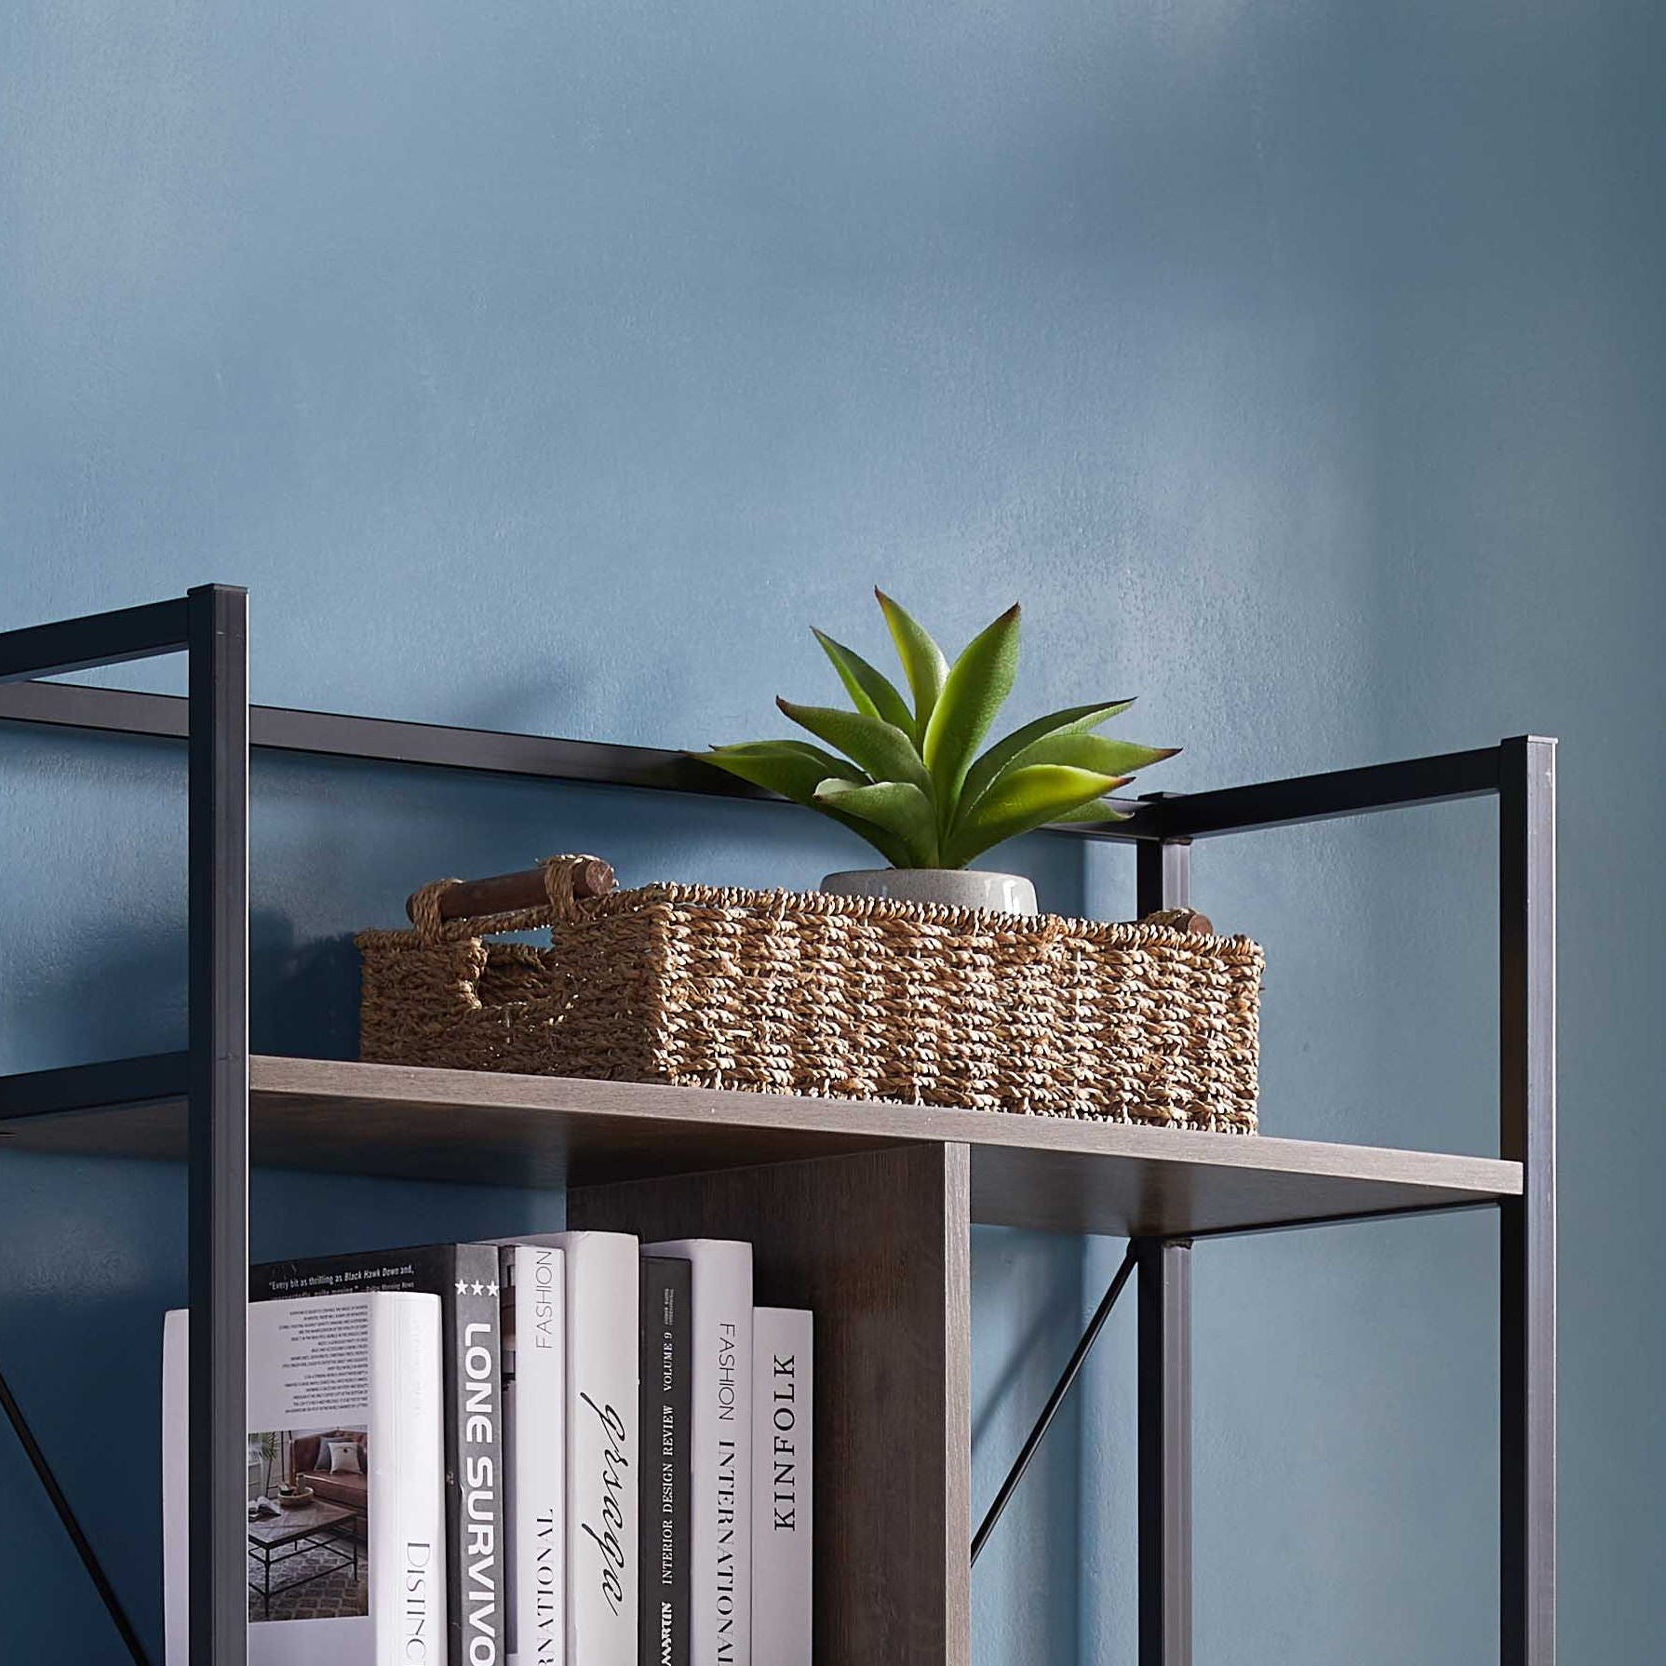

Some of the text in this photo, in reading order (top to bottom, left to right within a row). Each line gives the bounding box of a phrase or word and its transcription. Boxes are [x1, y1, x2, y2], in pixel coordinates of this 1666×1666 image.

[308, 1275, 333, 1285] thrilling
[344, 1271, 362, 1281] Black
[363, 1269, 381, 1279] Hawk
[382, 1267, 399, 1277] Down
[536, 1250, 553, 1348] FASHION
[465, 1322, 493, 1444] LONE
[663, 1343, 673, 1392] VOLUME
[719, 1323, 735, 1420] FASHION
[663, 1405, 674, 1456] REVIEW
[774, 1355, 795, 1532] KINFOLK
[662, 1463, 673, 1513] DESIGN
[662, 1520, 673, 1585] INTERIOR
